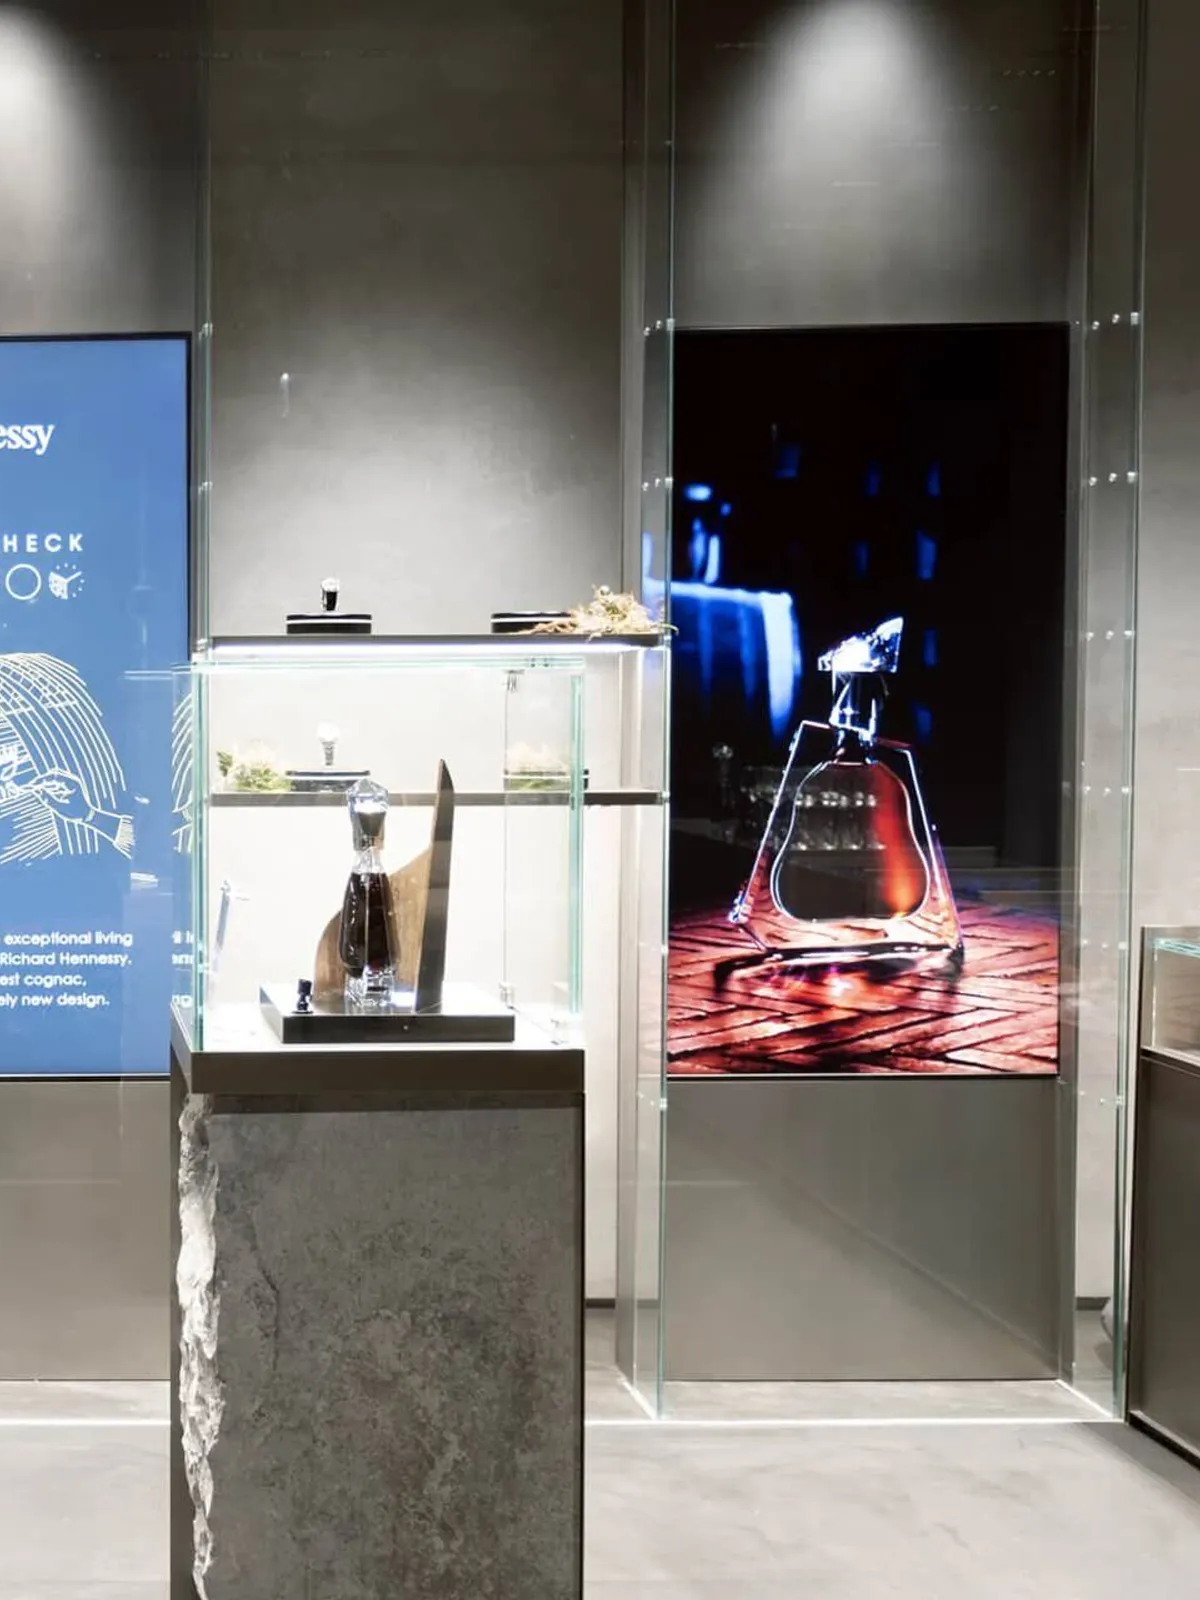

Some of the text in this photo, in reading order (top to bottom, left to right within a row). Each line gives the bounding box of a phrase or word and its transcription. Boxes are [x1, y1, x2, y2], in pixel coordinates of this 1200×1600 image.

[3, 931, 92, 948] exceptional
[95, 931, 133, 947] living
[0, 951, 56, 966] Richard
[59, 951, 132, 968] Hennessy.
[21, 995, 54, 1006] new
[57, 992, 110, 1009] design.
